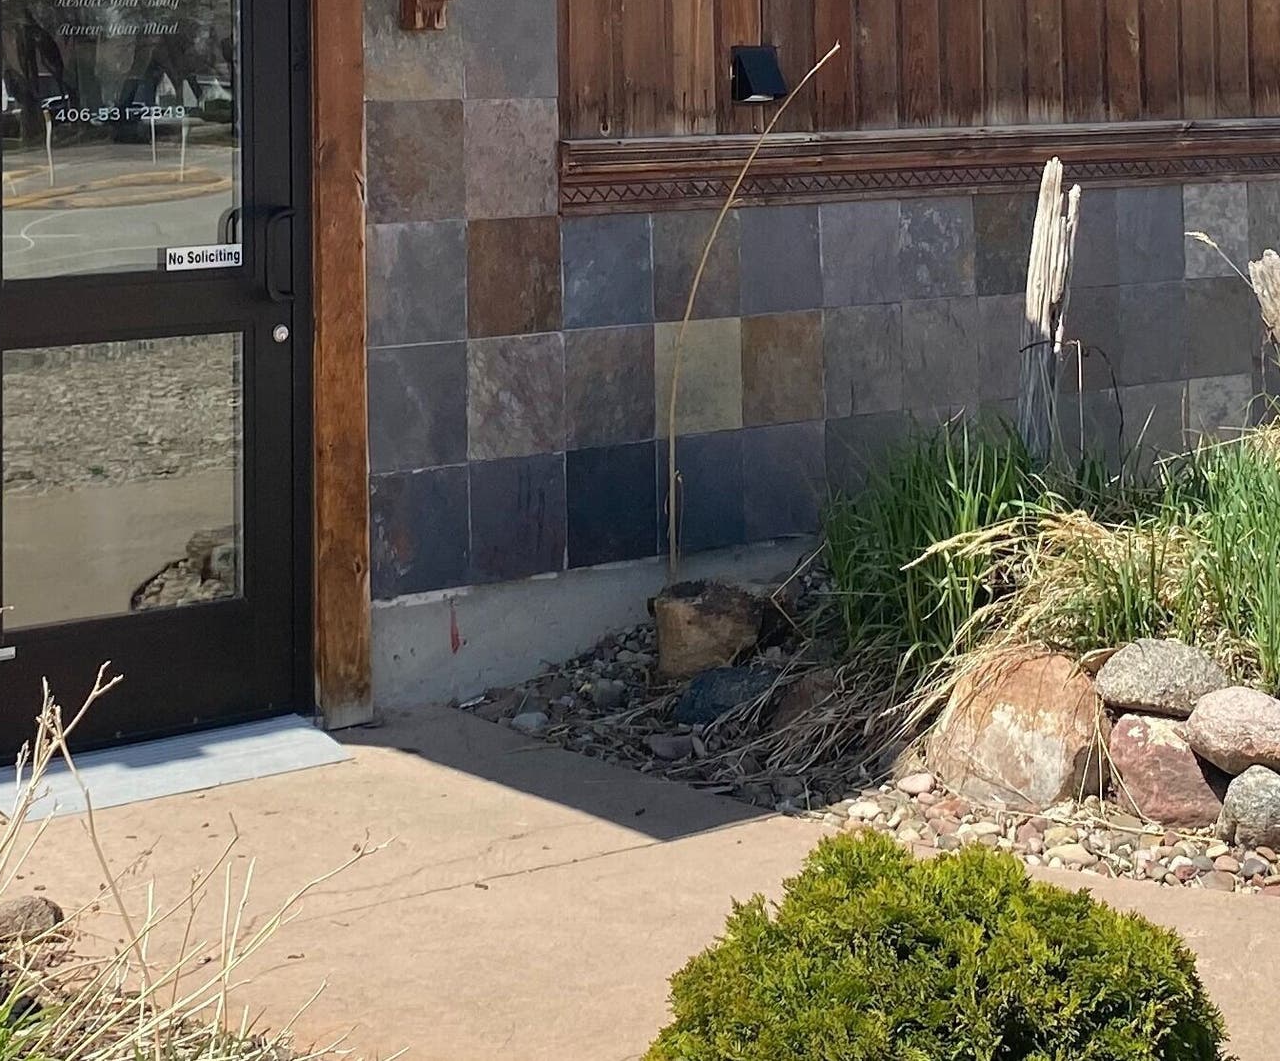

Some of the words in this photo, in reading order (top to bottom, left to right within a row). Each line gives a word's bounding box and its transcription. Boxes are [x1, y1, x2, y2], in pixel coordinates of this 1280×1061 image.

[57, 22, 104, 36] Renew
[107, 22, 140, 39] Your
[143, 21, 179, 35] Mind
[55, 105, 186, 122] 406-531-2849
[168, 252, 184, 266] No
[187, 249, 241, 264] Soliciting
